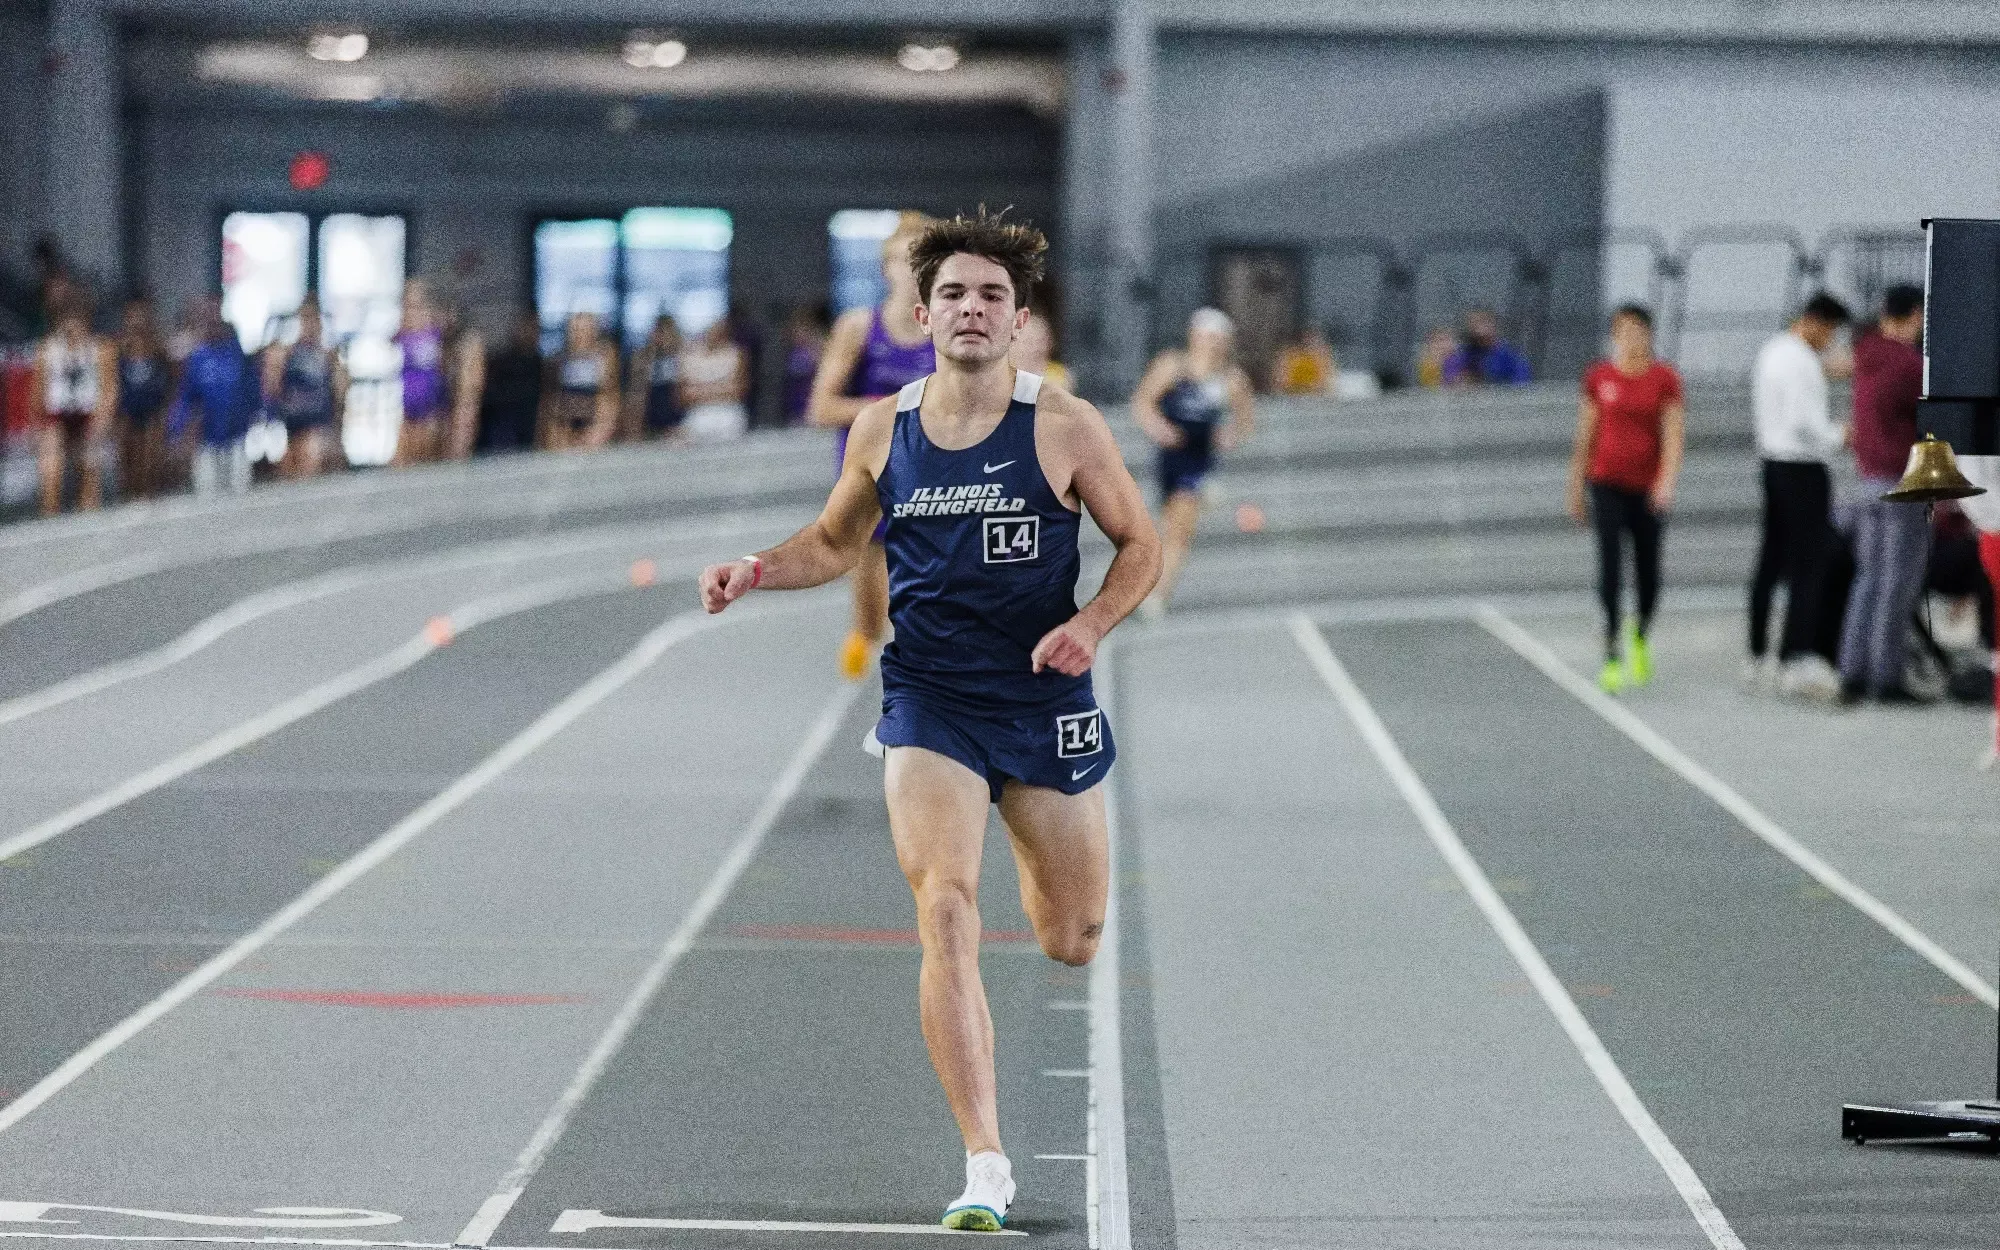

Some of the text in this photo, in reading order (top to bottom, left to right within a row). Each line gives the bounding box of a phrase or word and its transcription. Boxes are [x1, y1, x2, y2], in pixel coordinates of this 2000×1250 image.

[910, 484, 1004, 503] ILLINOIS
[893, 498, 1026, 518] SPRINGFIELD
[992, 524, 1032, 554] 14
[1065, 717, 1099, 749] 14
